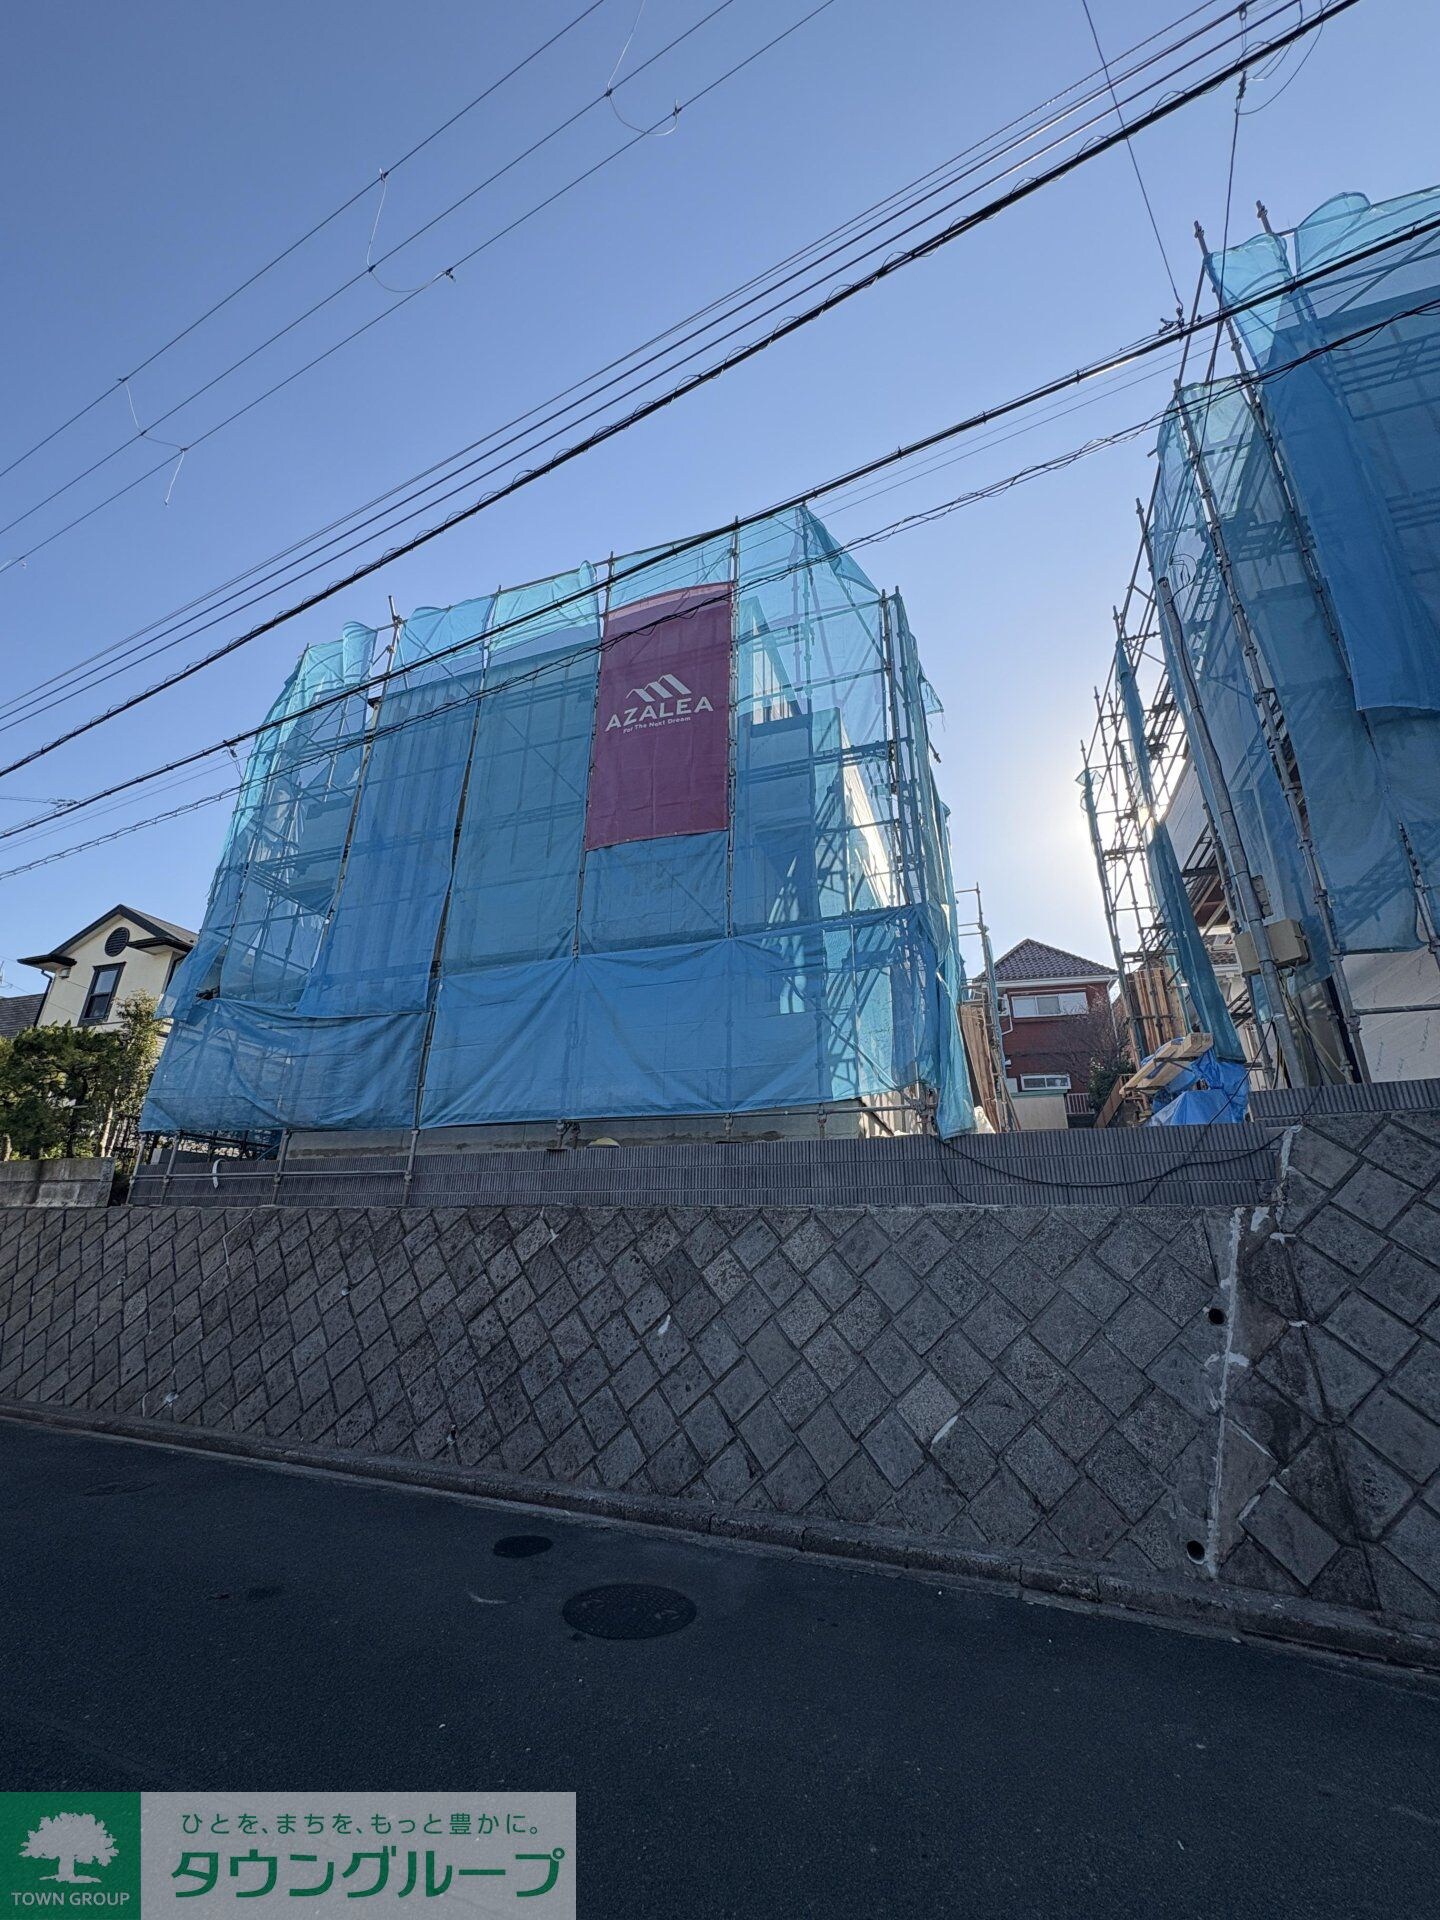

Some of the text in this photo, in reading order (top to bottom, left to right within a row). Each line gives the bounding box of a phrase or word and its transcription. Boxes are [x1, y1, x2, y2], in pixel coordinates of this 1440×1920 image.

[605, 696, 714, 732] AZALEA
[635, 723, 648, 731] The
[649, 720, 666, 728] Next
[667, 716, 691, 725] Dream
